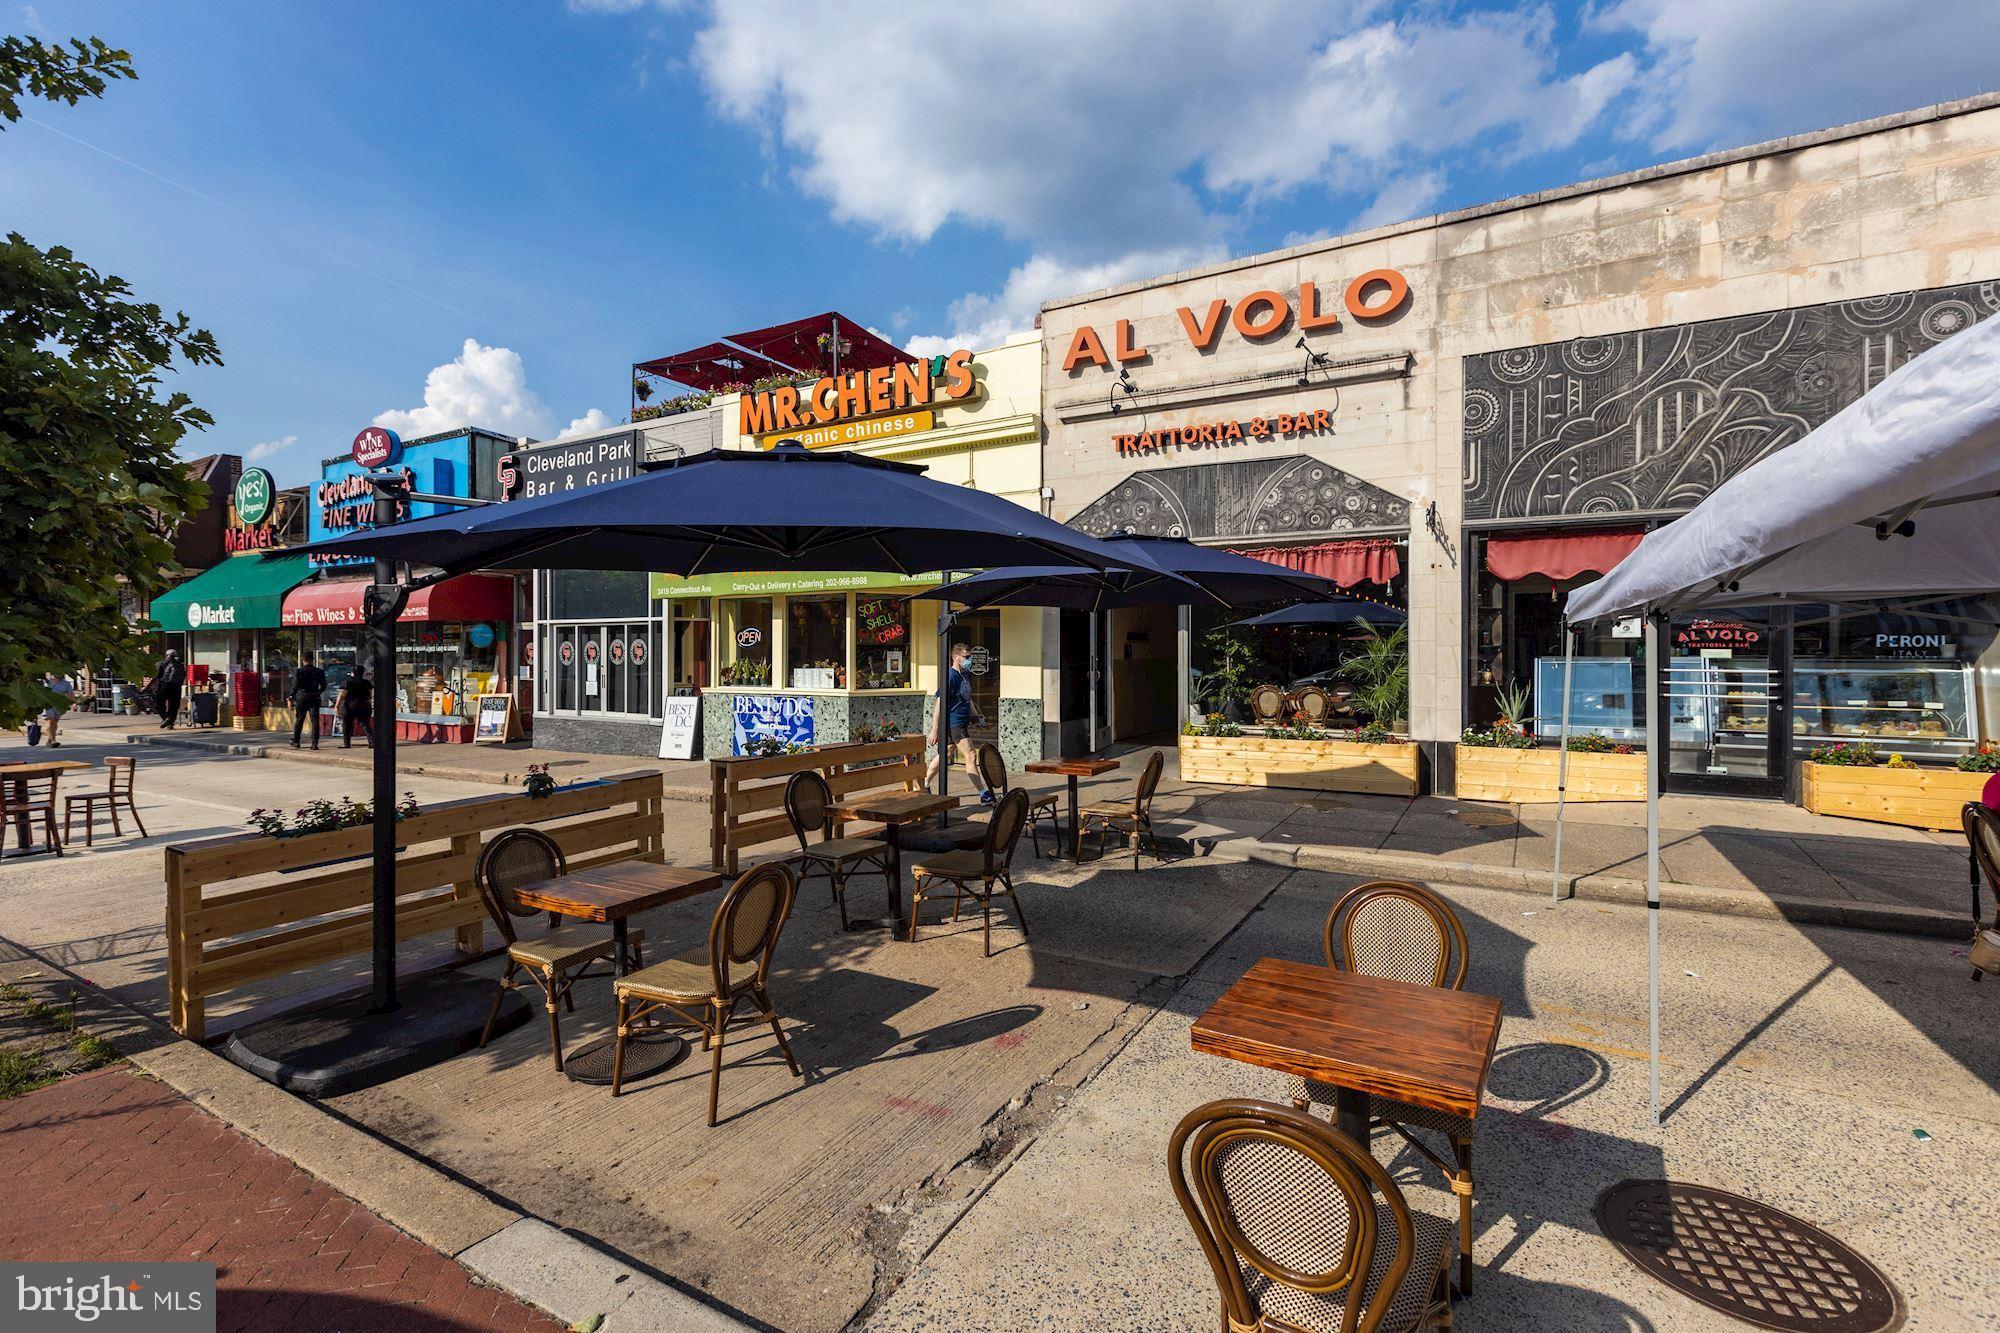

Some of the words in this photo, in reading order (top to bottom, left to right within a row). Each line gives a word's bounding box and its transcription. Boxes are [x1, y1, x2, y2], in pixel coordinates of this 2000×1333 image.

[1062, 318, 1148, 371] AL
[1176, 269, 1409, 350] VOLO
[778, 427, 839, 446] anic
[845, 416, 915, 438] chinese
[1111, 420, 1242, 453] TRATTORIA
[1250, 416, 1269, 436] &
[1277, 409, 1330, 433] BAR
[359, 433, 383, 451] WINE
[357, 448, 387, 464] Specialists
[527, 446, 593, 474] Cleveland
[599, 440, 632, 466] Park
[526, 480, 555, 498] Bar
[565, 474, 575, 491] &
[586, 466, 630, 486] Grill
[238, 476, 265, 516] yes!
[244, 502, 264, 514] Organic
[321, 504, 351, 529] FINE
[225, 526, 272, 552] Market
[657, 587, 669, 595] 3419
[669, 585, 700, 595] Connecticut
[701, 585, 712, 593] Ave
[732, 582, 760, 592] Carry-Out
[767, 580, 791, 590] Delivery
[797, 579, 824, 589] Catering
[825, 576, 868, 587] 202-966-8988
[202, 604, 235, 624] Market
[294, 609, 314, 625] Fine
[316, 607, 345, 623] Wines
[858, 600, 882, 617] SOFT
[866, 613, 895, 630] SHELL
[737, 631, 761, 643] OPEN
[878, 625, 905, 643] CRAB
[1678, 630, 1700, 642] AL
[1705, 629, 1759, 642] VOLO
[1875, 633, 1946, 648] PERONI
[668, 703, 694, 716] BEST
[736, 696, 774, 715] BEST
[772, 697, 784, 716] of
